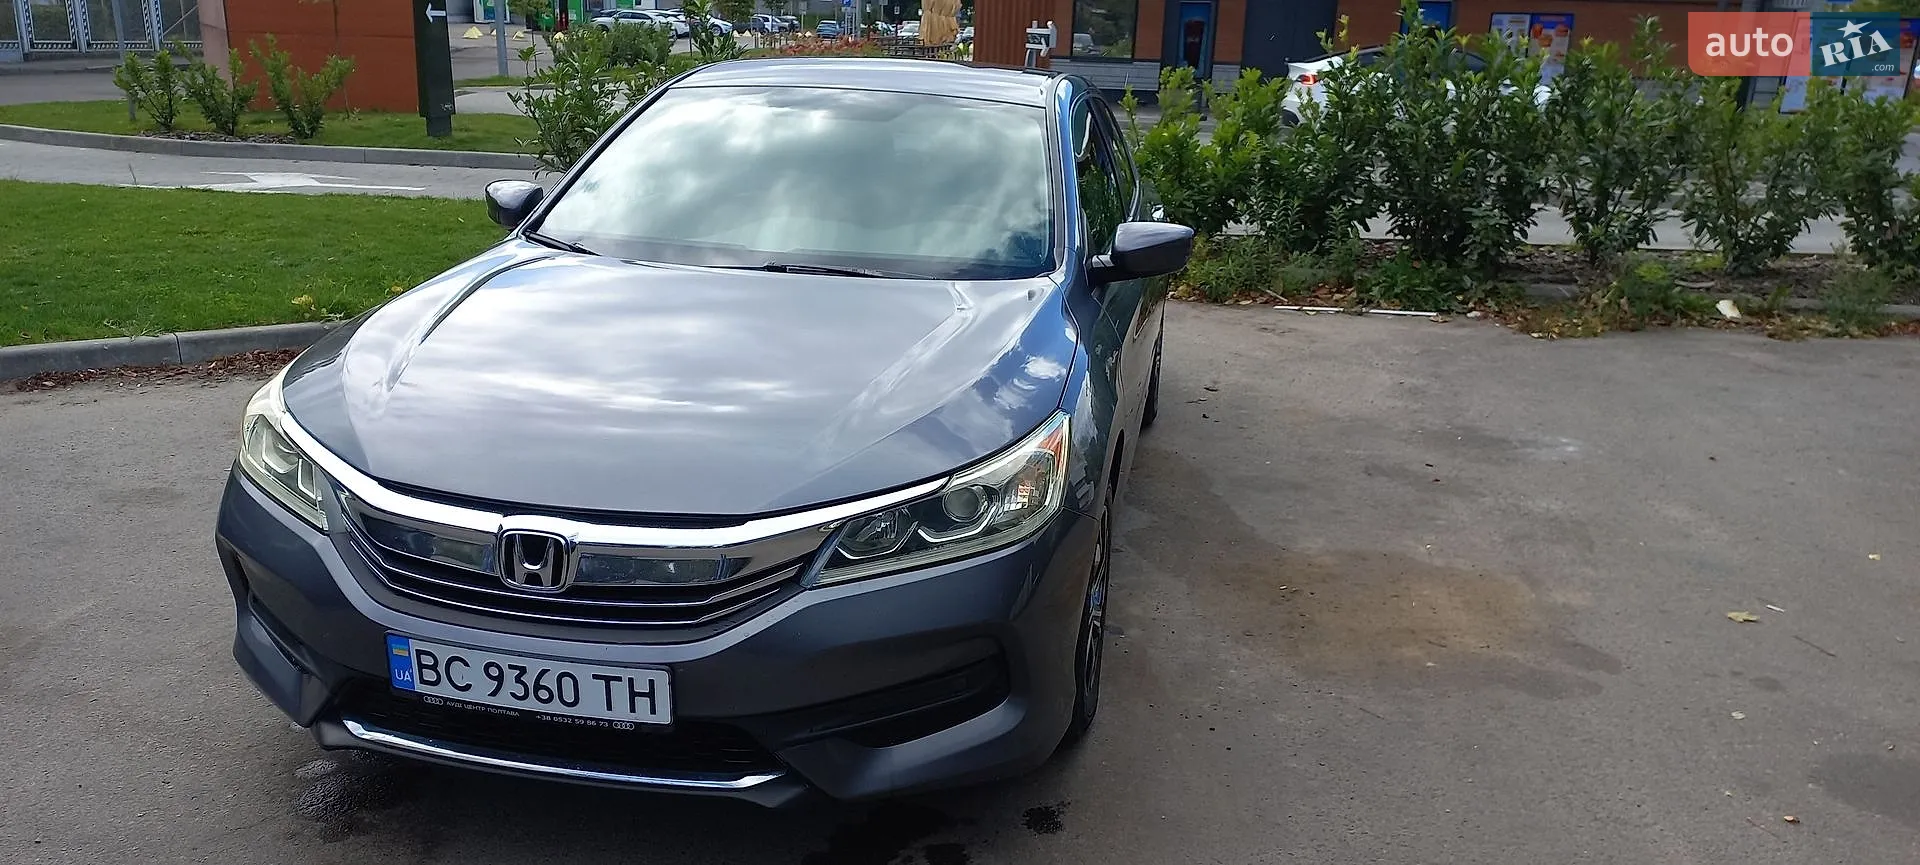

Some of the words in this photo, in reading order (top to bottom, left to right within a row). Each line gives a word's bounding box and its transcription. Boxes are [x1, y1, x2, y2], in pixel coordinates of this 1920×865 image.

[395, 669, 412, 683] UA
[415, 648, 473, 692] BC
[483, 661, 581, 708] 9360
[592, 673, 657, 715] TH
[487, 708, 520, 717] ПОЛТАВА
[553, 716, 573, 724] 0532
